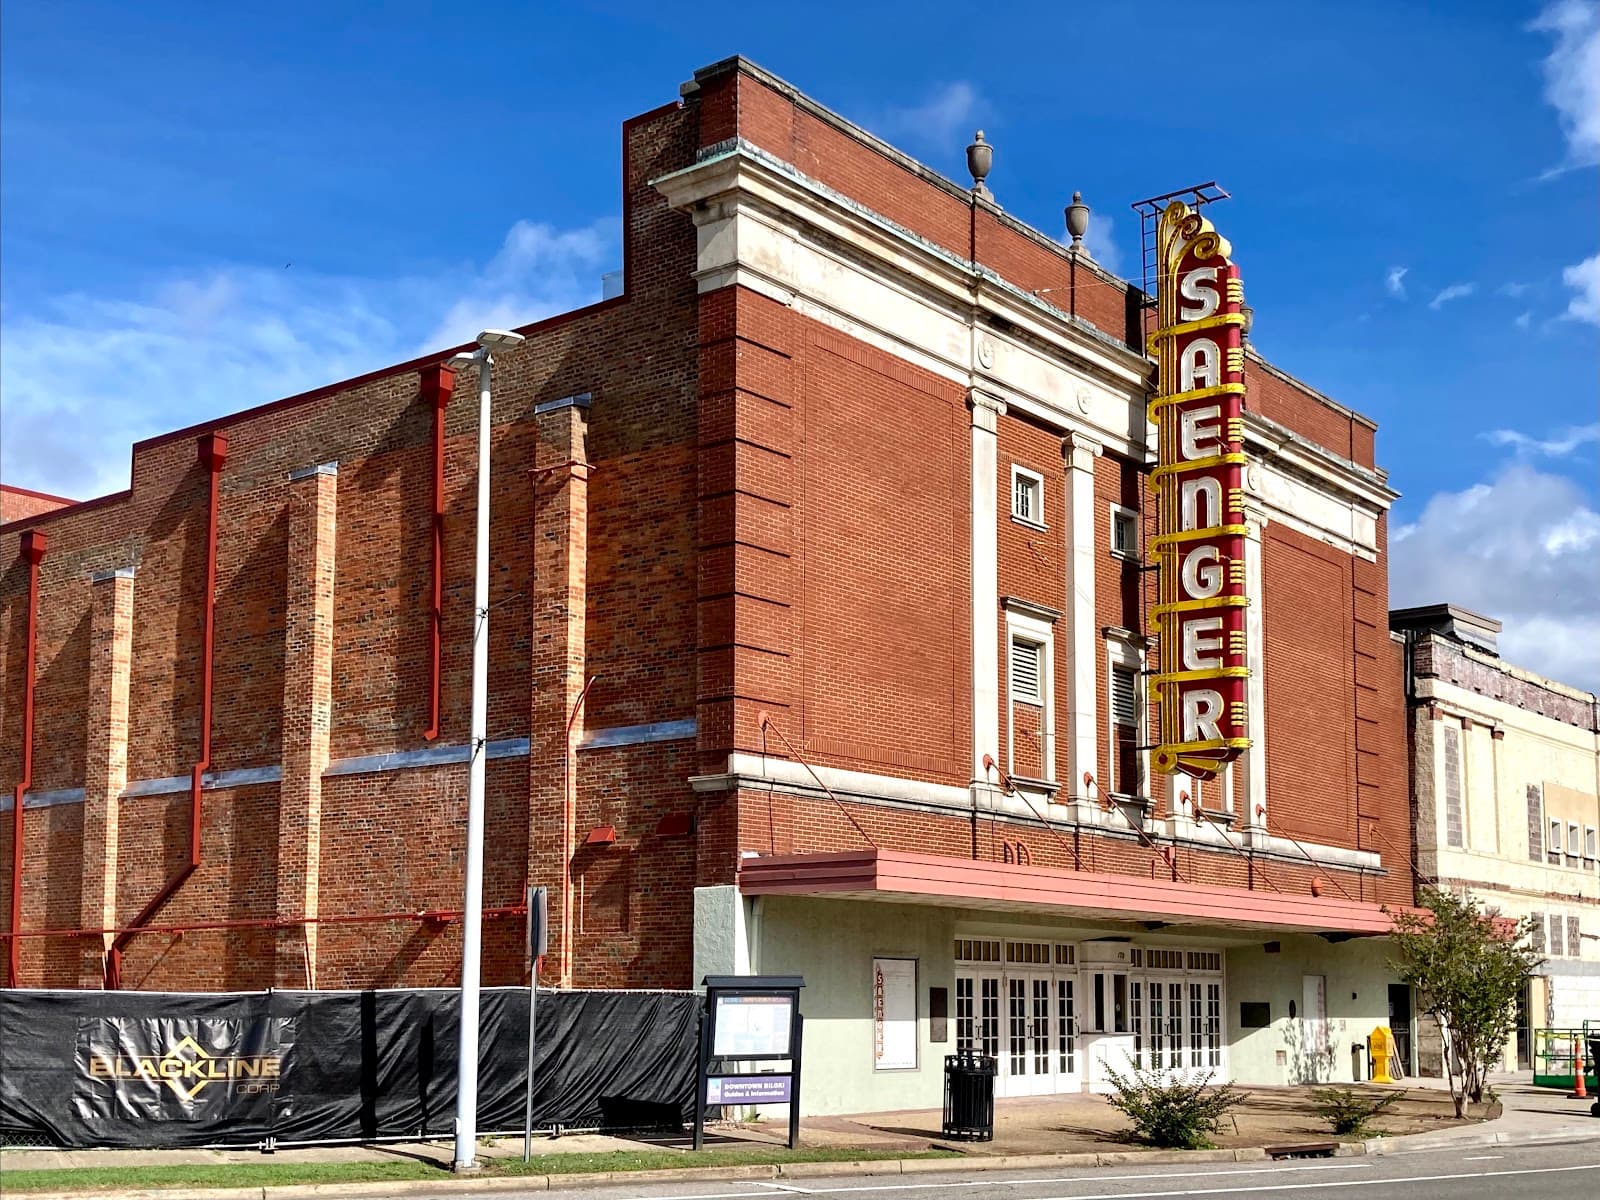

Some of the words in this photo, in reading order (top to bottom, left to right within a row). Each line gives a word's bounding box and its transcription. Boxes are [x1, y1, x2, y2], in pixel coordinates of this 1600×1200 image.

[1181, 266, 1224, 744] SAENGER
[89, 1058, 281, 1078] BLACKLINE
[236, 1083, 281, 1094] CORP
